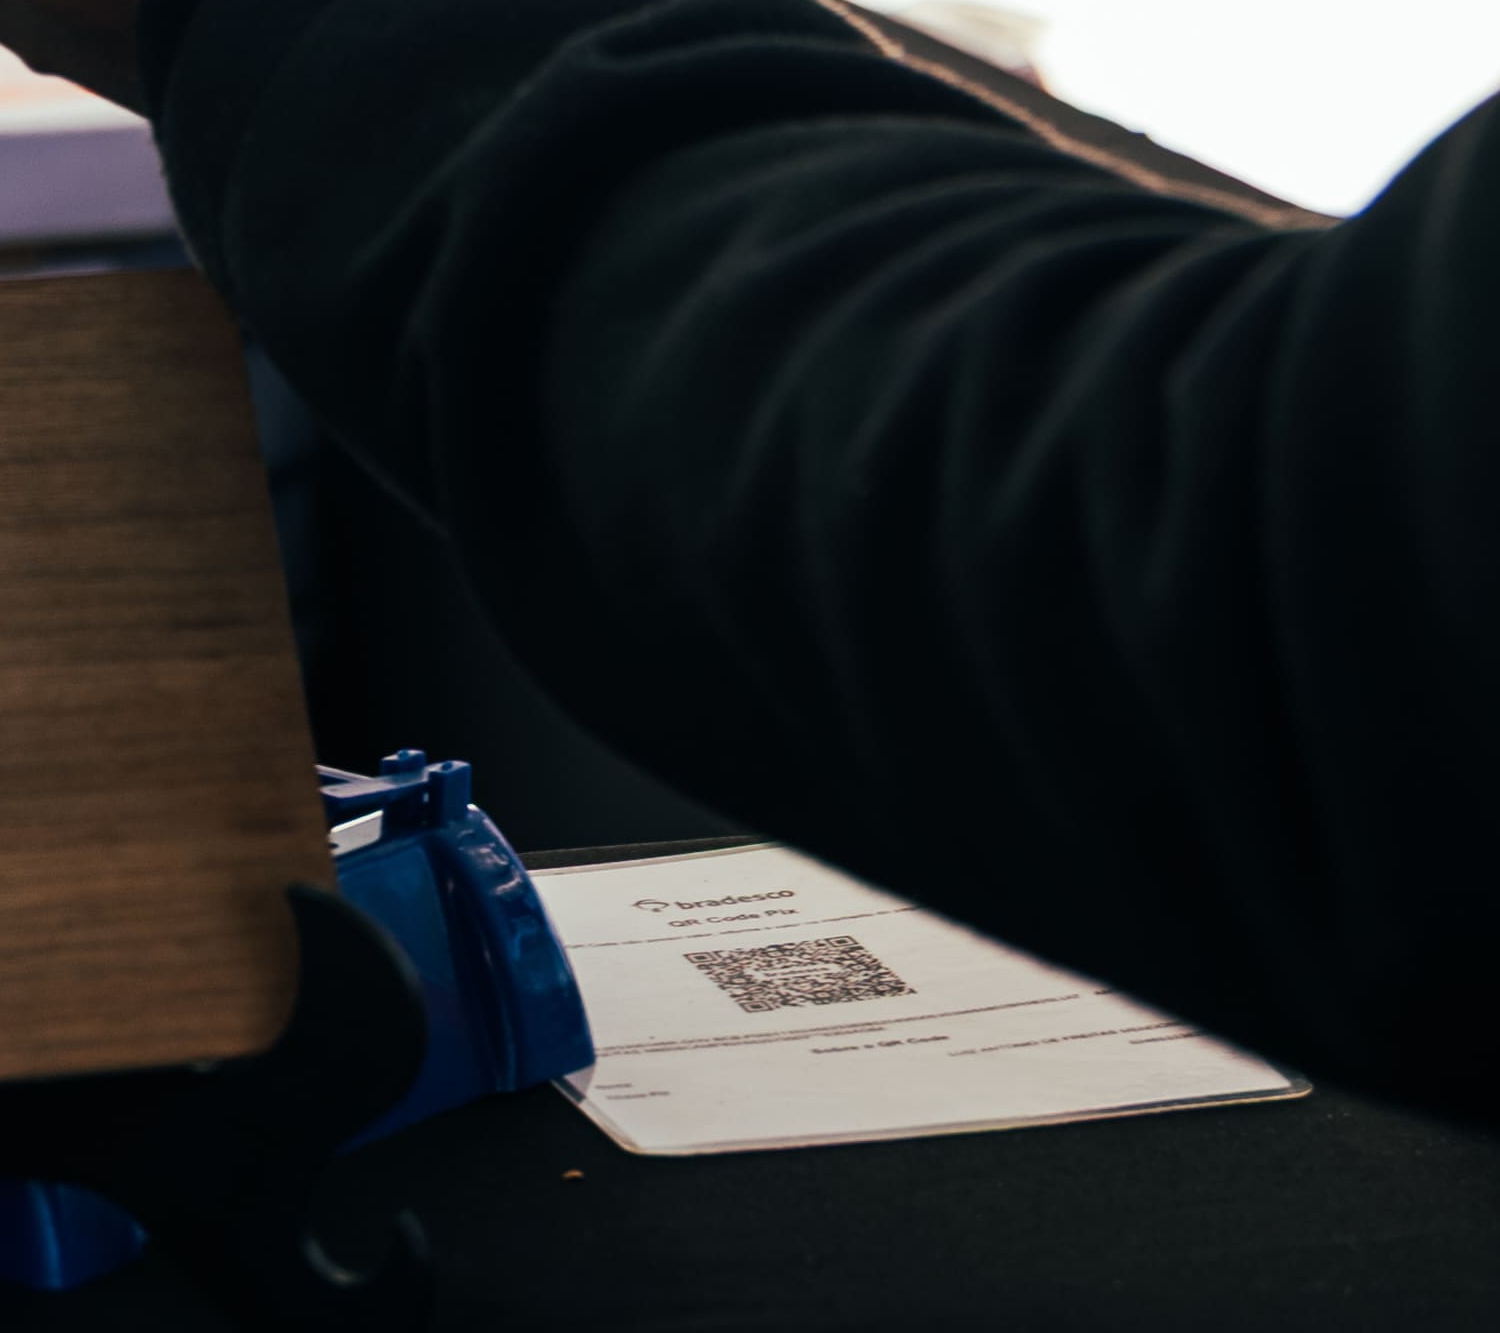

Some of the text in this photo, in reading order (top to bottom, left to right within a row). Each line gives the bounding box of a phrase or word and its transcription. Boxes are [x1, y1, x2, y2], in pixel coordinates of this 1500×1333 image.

[675, 890, 796, 910] bradesco
[668, 917, 701, 928] QR
[706, 912, 760, 924] Code
[764, 907, 798, 917] Pix
